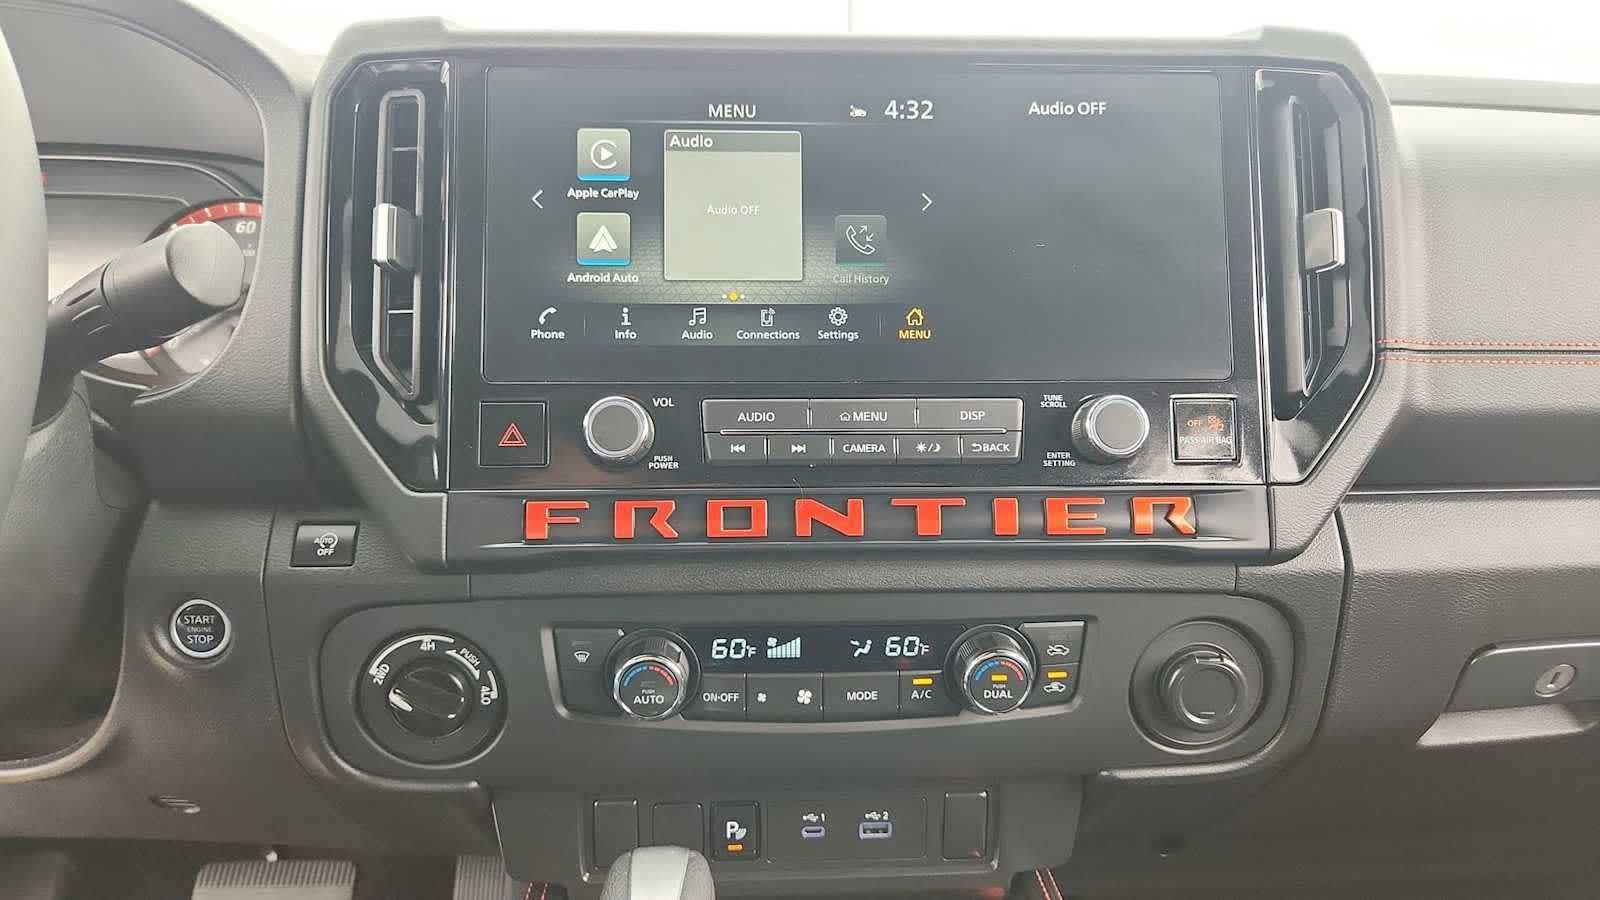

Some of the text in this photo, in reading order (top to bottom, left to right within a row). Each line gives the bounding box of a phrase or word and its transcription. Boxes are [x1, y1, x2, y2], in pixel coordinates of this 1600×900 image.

[708, 103, 757, 118] MENU
[884, 99, 934, 120] 4:32
[1028, 101, 1107, 116] Audio OFF
[669, 134, 714, 149] Audio
[567, 187, 640, 201] Apple CarPlay
[706, 203, 761, 216] Audio OFF
[236, 220, 257, 234] 60
[567, 271, 639, 284] Android Auto
[832, 272, 890, 286] Call History
[530, 329, 565, 340] Phone
[614, 329, 637, 340] Info
[681, 328, 714, 341] Audio
[736, 329, 800, 341] Connections
[817, 328, 859, 343] Settings
[899, 328, 931, 340] MENU
[652, 397, 675, 407] VOL
[1043, 394, 1063, 402] TUNE
[737, 411, 775, 423] AUDIO
[853, 410, 888, 422] MENU
[959, 410, 986, 421] DISP
[842, 443, 886, 454] CAMERA
[983, 442, 1010, 454] BACK
[1046, 451, 1071, 460] ENTER
[648, 462, 679, 470] POWER
[1042, 459, 1076, 467] SETTING
[524, 497, 1196, 539] FRONTIER
[313, 537, 334, 545] AUTO
[317, 548, 335, 556] OFF
[184, 614, 216, 624] START
[187, 634, 214, 644] STOP
[420, 641, 436, 652] 4H
[459, 647, 481, 667] PUSH
[373, 663, 390, 686] 2WD
[481, 685, 491, 705] 4LO
[633, 694, 665, 706] AUTO
[846, 690, 878, 701] MODE
[911, 689, 933, 700] A/C
[983, 689, 1013, 699] DUAL
[820, 813, 826, 823] 1
[882, 811, 889, 821] 2
